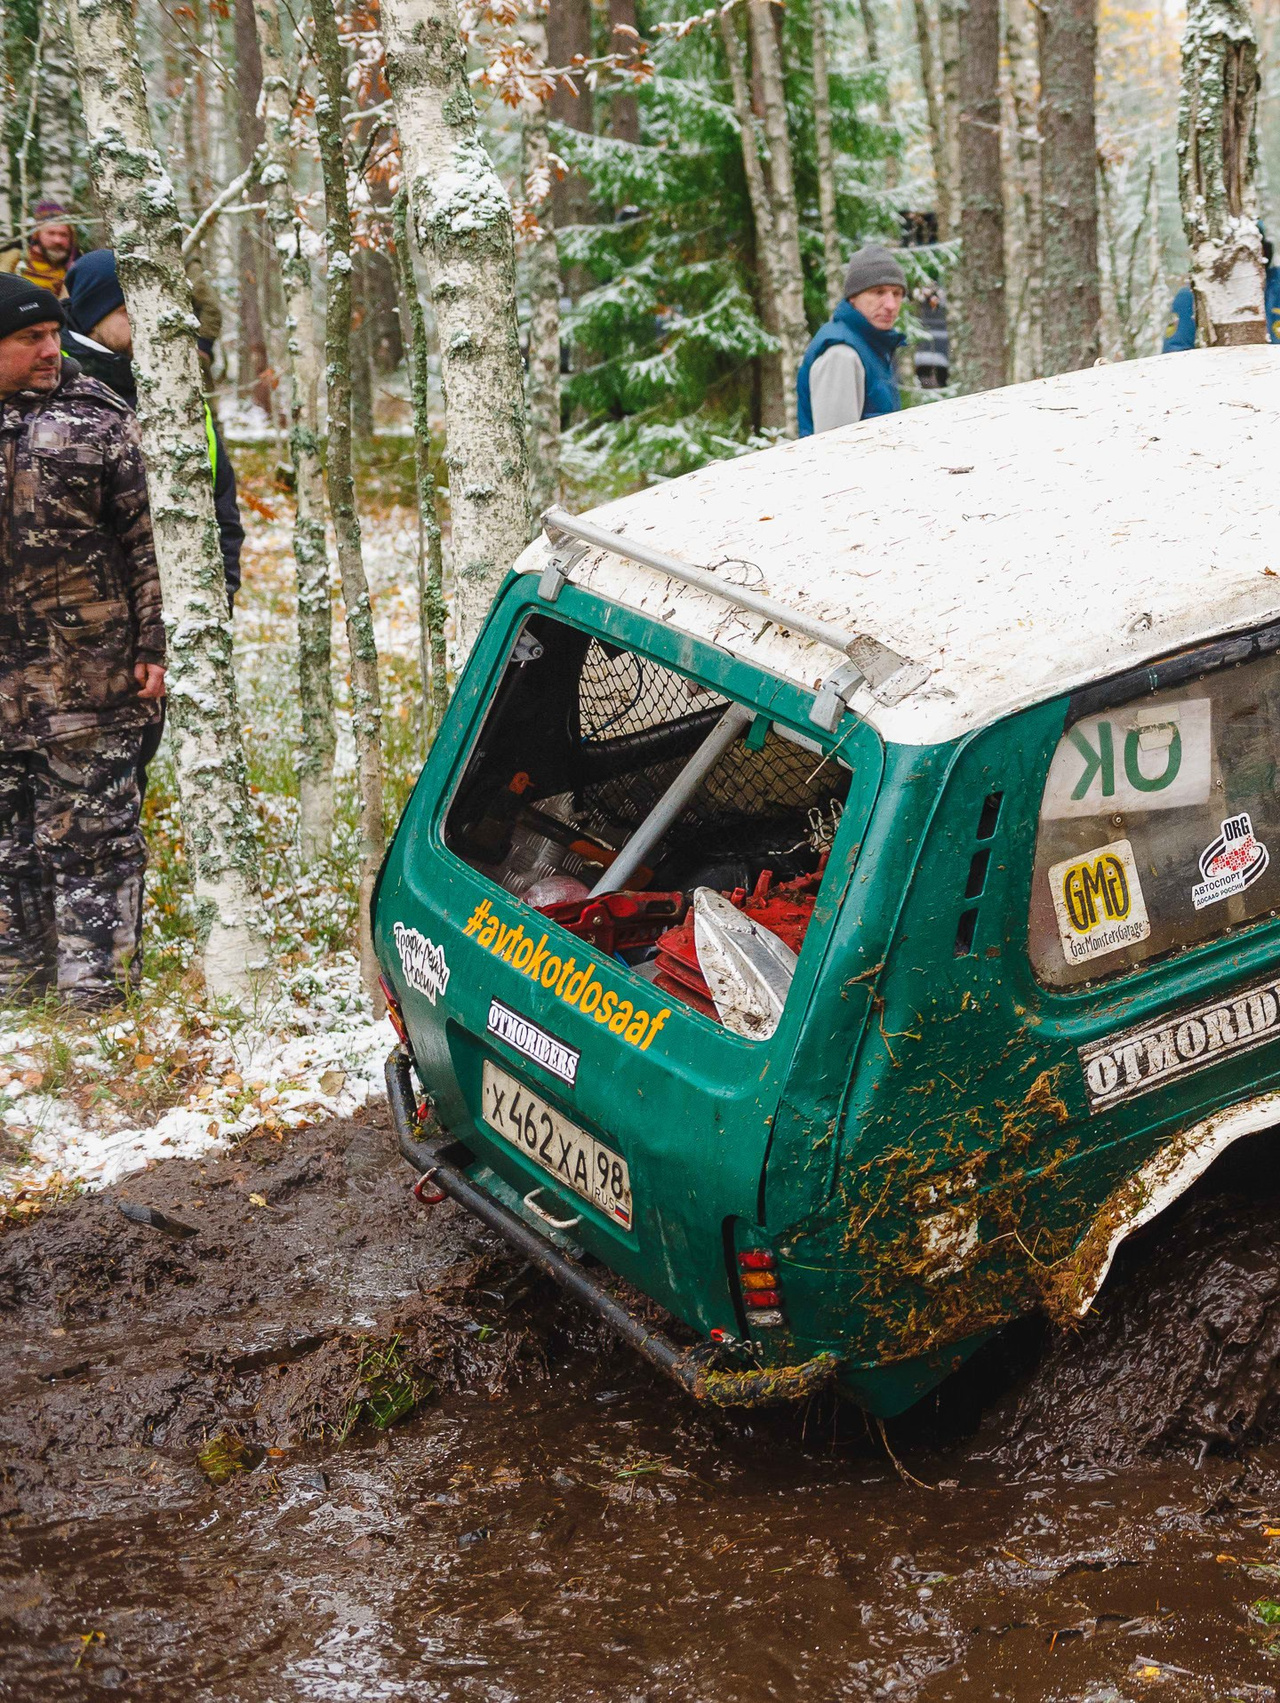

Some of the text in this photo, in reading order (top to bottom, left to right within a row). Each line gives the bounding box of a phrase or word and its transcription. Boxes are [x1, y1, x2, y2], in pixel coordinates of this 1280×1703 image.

[1224, 816, 1250, 841] ORG
[1194, 871, 1240, 897] АВТОСПОРТ
[1197, 882, 1244, 906] ДОСААФ РОССИИ
[462, 899, 671, 1051] #avtokotdosaaf
[488, 1005, 577, 1080] OTMORIDERS
[593, 1186, 615, 1211] RUS
